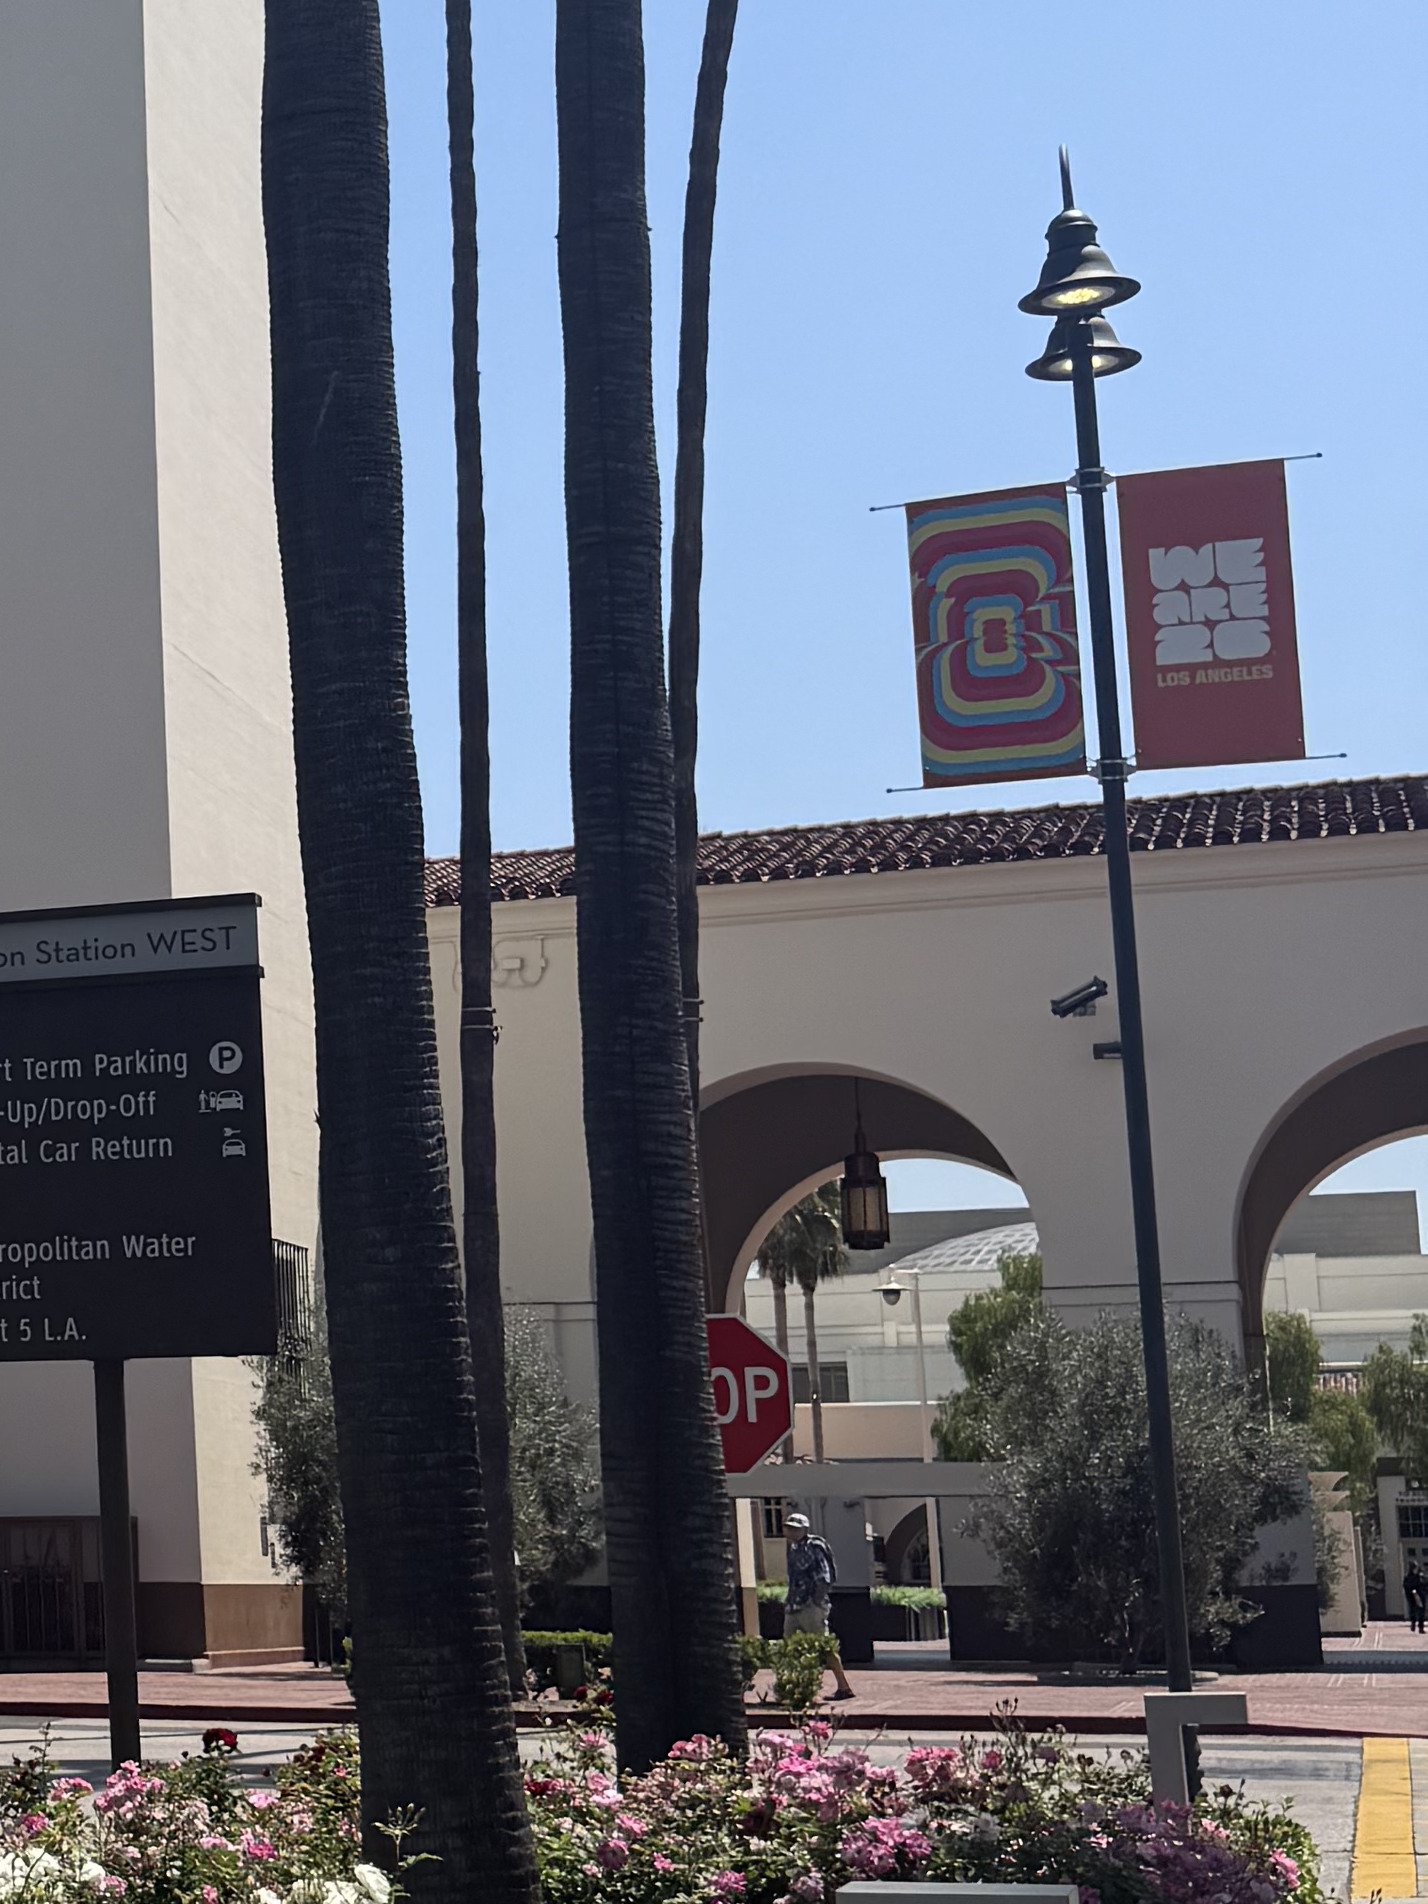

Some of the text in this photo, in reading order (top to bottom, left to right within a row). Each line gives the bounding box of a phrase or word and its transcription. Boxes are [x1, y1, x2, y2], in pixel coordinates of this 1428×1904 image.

[1148, 537, 1267, 590] WE
[1152, 582, 1270, 626] ARE
[1154, 618, 1272, 666] 26
[1156, 665, 1274, 688] LOS ANGELES
[35, 937, 136, 965] Station
[146, 925, 238, 955] WEST
[23, 1055, 82, 1081] Term
[95, 1049, 188, 1079] Parking
[39, 1139, 80, 1163] Car
[91, 1134, 173, 1161] Return
[122, 1234, 196, 1259] Water
[19, 1319, 32, 1342] 5
[44, 1317, 88, 1342] L.A.
[710, 1366, 779, 1425] OP
